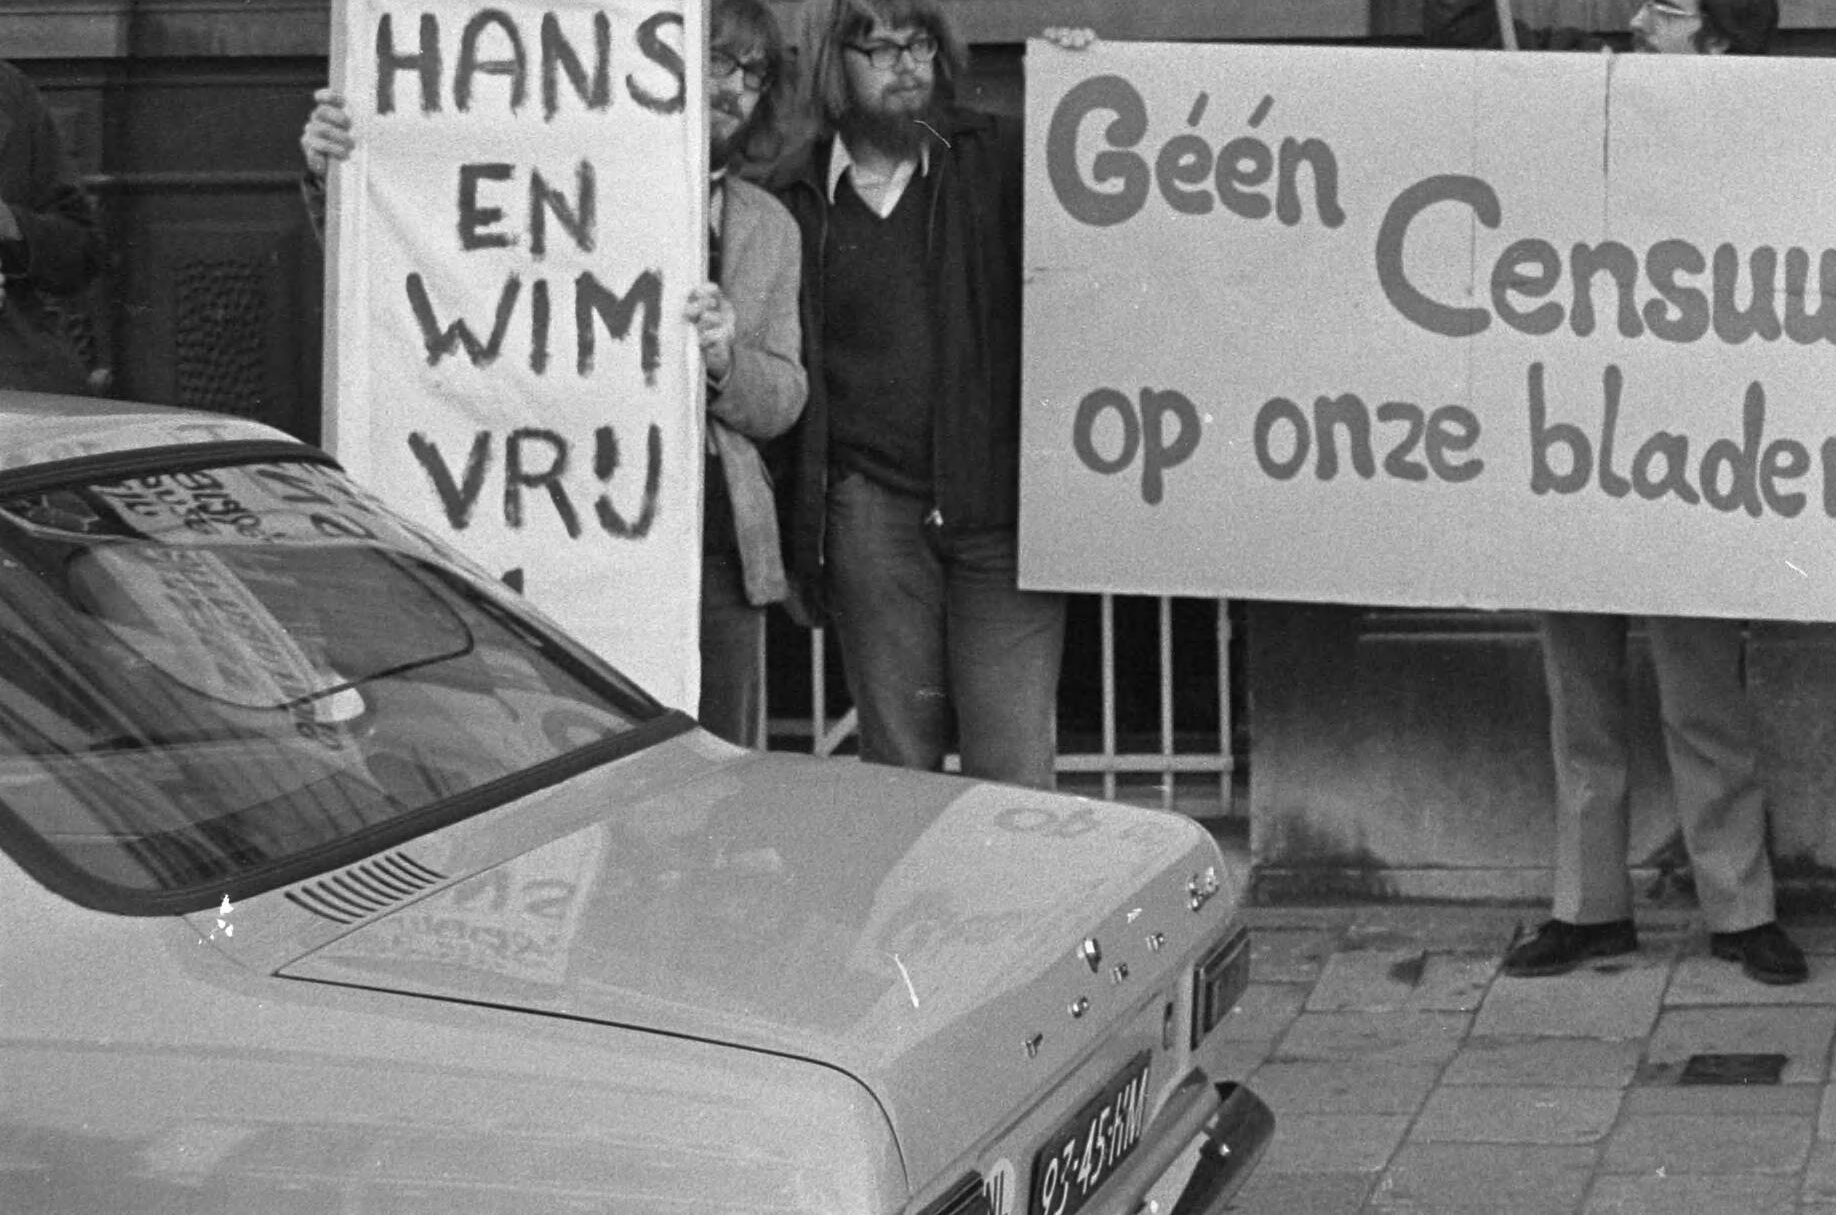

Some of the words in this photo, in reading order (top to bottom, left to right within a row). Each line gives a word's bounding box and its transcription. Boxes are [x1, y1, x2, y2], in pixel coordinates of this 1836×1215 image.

[376, 8, 686, 123] HANS
[458, 159, 597, 260] EN
[1046, 74, 1347, 228] Géén
[405, 269, 664, 387] WIM
[1072, 386, 1202, 506] op
[1253, 392, 1485, 483] onze
